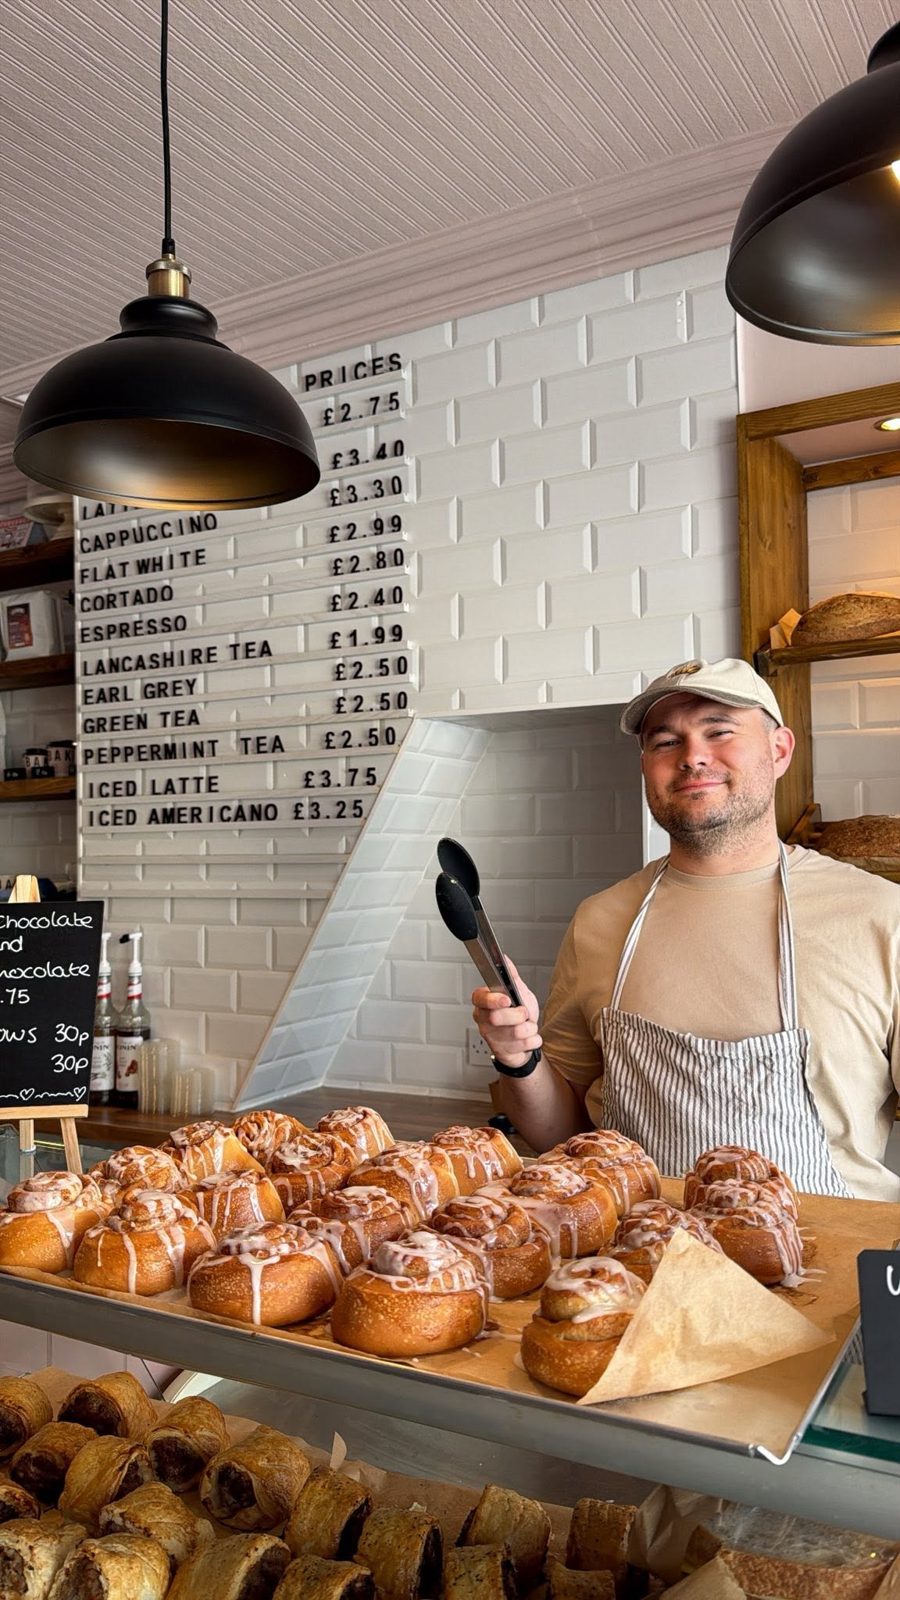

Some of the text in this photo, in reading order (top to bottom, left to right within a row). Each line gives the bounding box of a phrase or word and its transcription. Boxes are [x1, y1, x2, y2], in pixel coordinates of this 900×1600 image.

[305, 353, 402, 391] PRICES
[323, 392, 400, 426] £2.75
[332, 440, 404, 469] £3.40
[330, 476, 403, 506] £3.30
[80, 513, 402, 553] CAPPUCCINO £2.99
[333, 549, 404, 575] £2.80
[80, 585, 403, 613] CORTADO £2.40
[81, 615, 403, 649] ESPRESSO £1.99
[83, 640, 408, 680] LANCASHIRE TEA £2.50
[84, 678, 408, 713] EARL GREY £2.50
[84, 709, 396, 749] GREEN TEA £2.50
[84, 735, 285, 764] PEPPERMINT TEA
[89, 767, 377, 798] ICED LATTE £3.75
[89, 800, 364, 826] ICED AMERICANO £3.25
[55, 1024, 89, 1046] 30p
[51, 1055, 88, 1073] 30p
